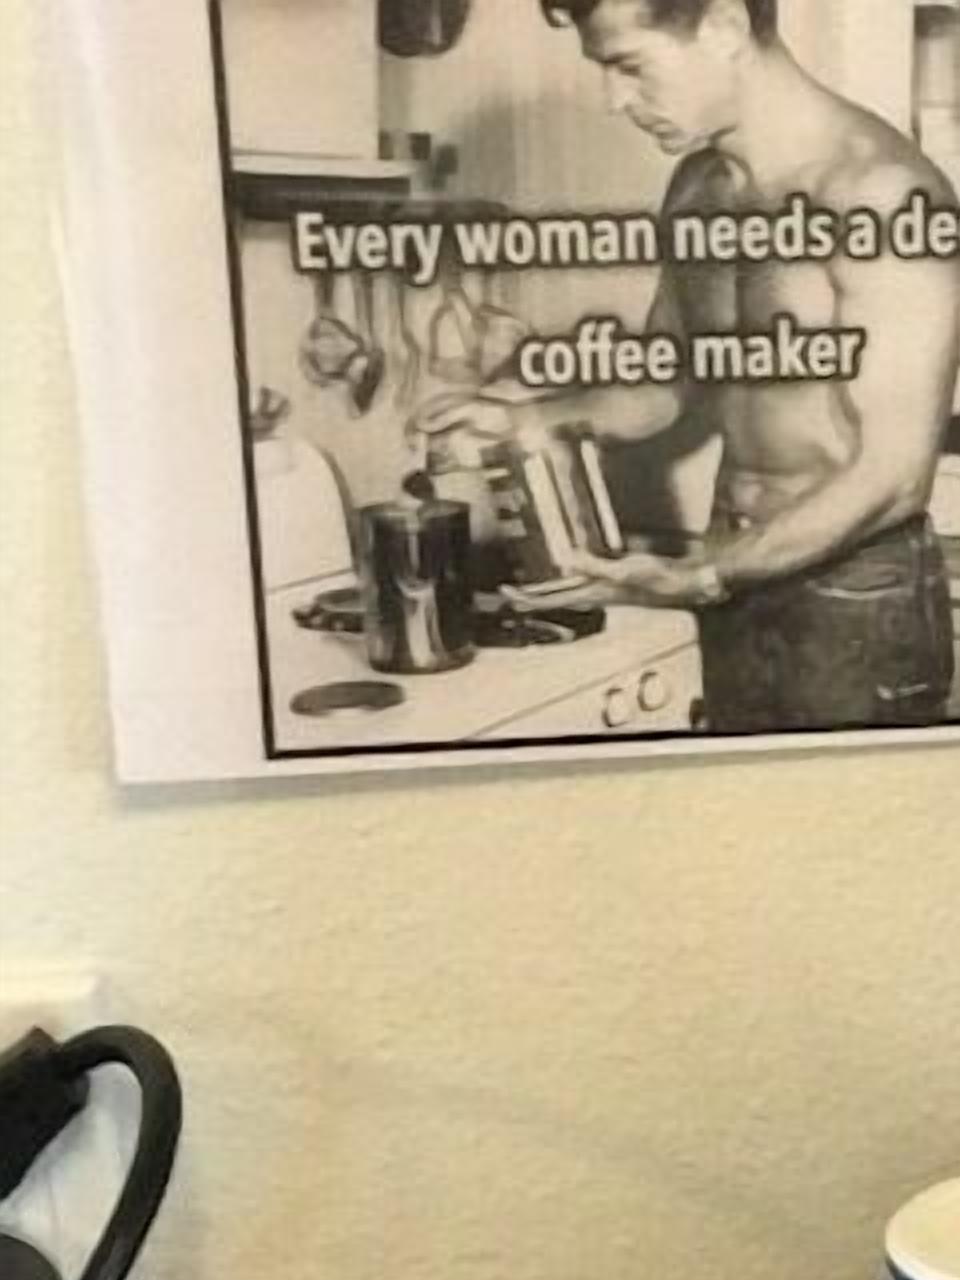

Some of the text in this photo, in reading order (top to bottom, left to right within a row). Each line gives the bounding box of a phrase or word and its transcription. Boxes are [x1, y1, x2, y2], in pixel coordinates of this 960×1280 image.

[294, 211, 442, 284] Every
[455, 216, 657, 266] woman
[673, 196, 833, 261] needs
[845, 212, 875, 258] a
[519, 315, 866, 385] coffee maker
